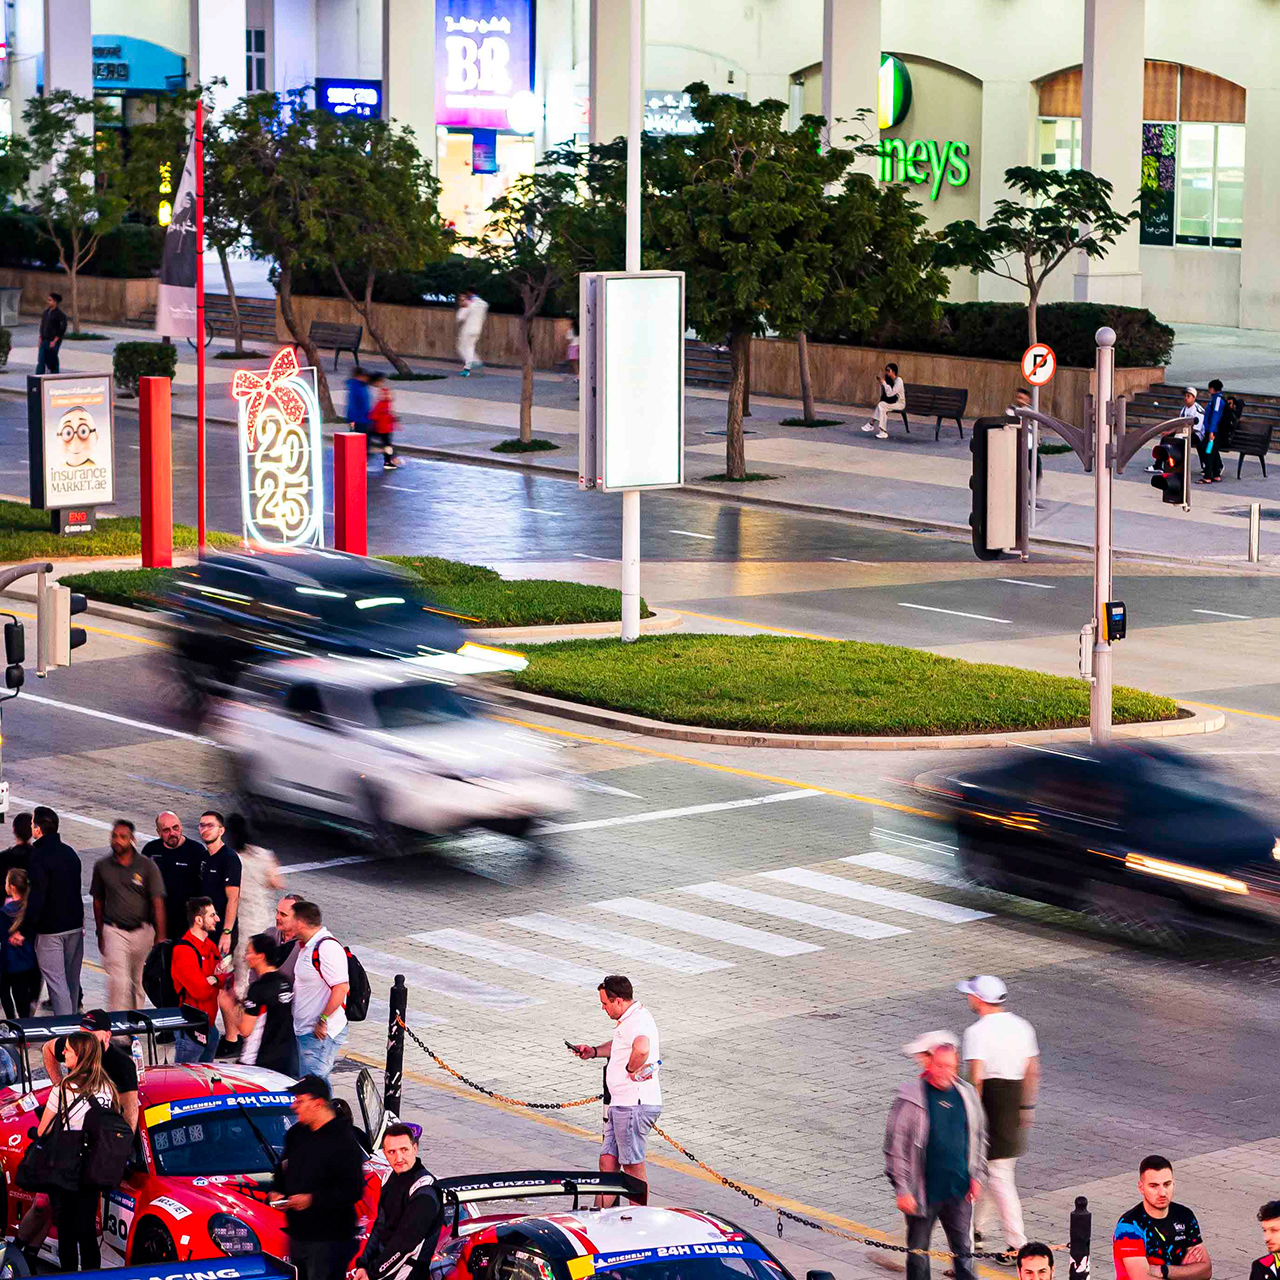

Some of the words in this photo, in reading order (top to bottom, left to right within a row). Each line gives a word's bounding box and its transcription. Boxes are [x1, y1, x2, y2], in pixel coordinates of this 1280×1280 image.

[878, 137, 969, 201] neys
[51, 466, 107, 480] insurance
[51, 479, 107, 493] MARKET.ae
[182, 1100, 222, 1112] MICHELIN
[225, 1095, 256, 1106] 24H
[257, 1093, 296, 1105] DUBA
[492, 1178, 546, 1189] GAZOO
[607, 1250, 652, 1264] MICHELIN
[657, 1246, 690, 1258] 24H
[693, 1243, 744, 1257] DUBAI
